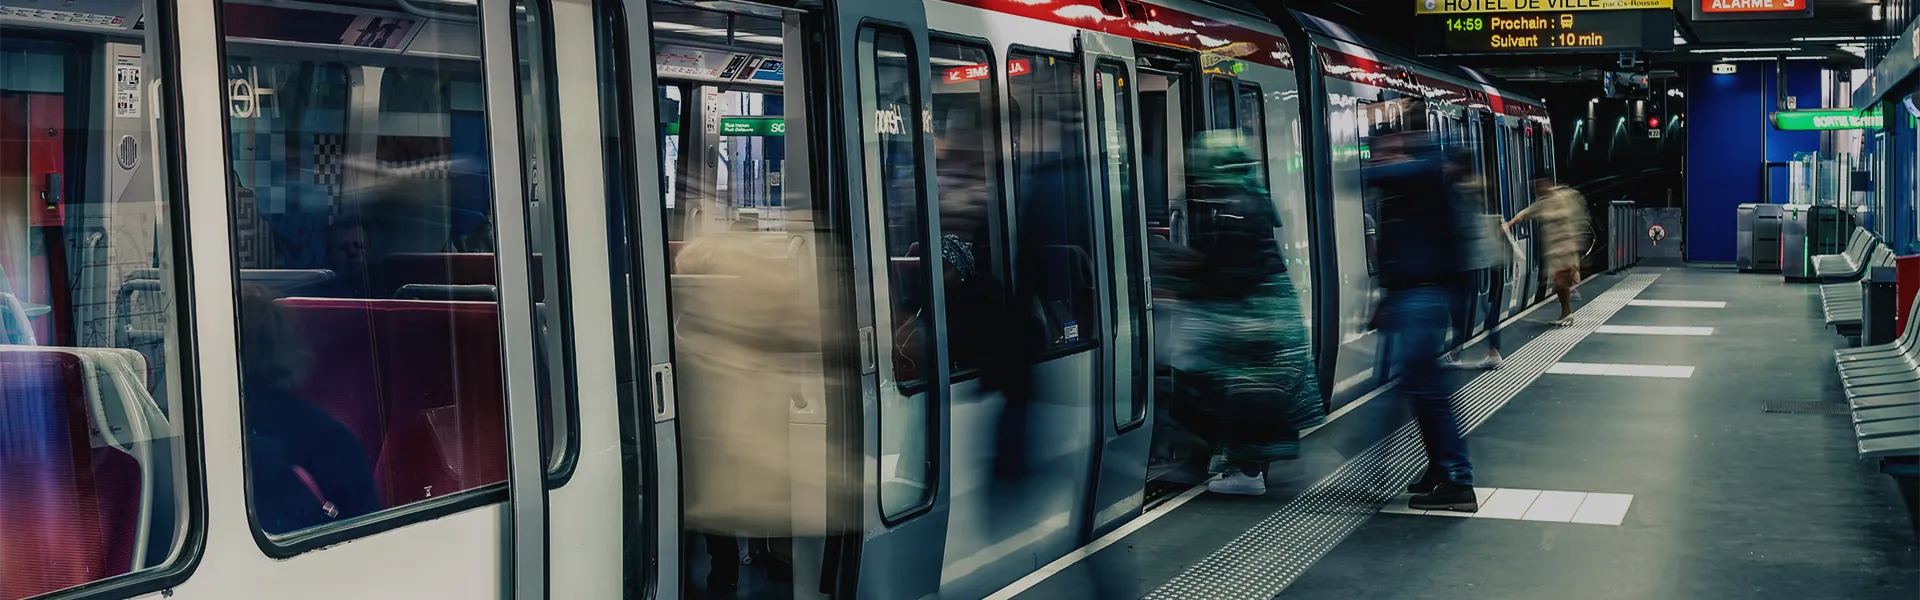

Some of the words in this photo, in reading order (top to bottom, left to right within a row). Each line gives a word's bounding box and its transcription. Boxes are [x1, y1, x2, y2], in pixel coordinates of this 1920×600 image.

[1514, 0, 1540, 10] DE
[1547, 0, 1600, 8] VILLE
[1711, 0, 1774, 9] ALARME
[1446, 18, 1483, 31] 14:59
[1490, 16, 1548, 30] Prochain
[1490, 34, 1538, 48] Suivant
[1558, 33, 1576, 46] 10
[1578, 32, 1603, 46] min
